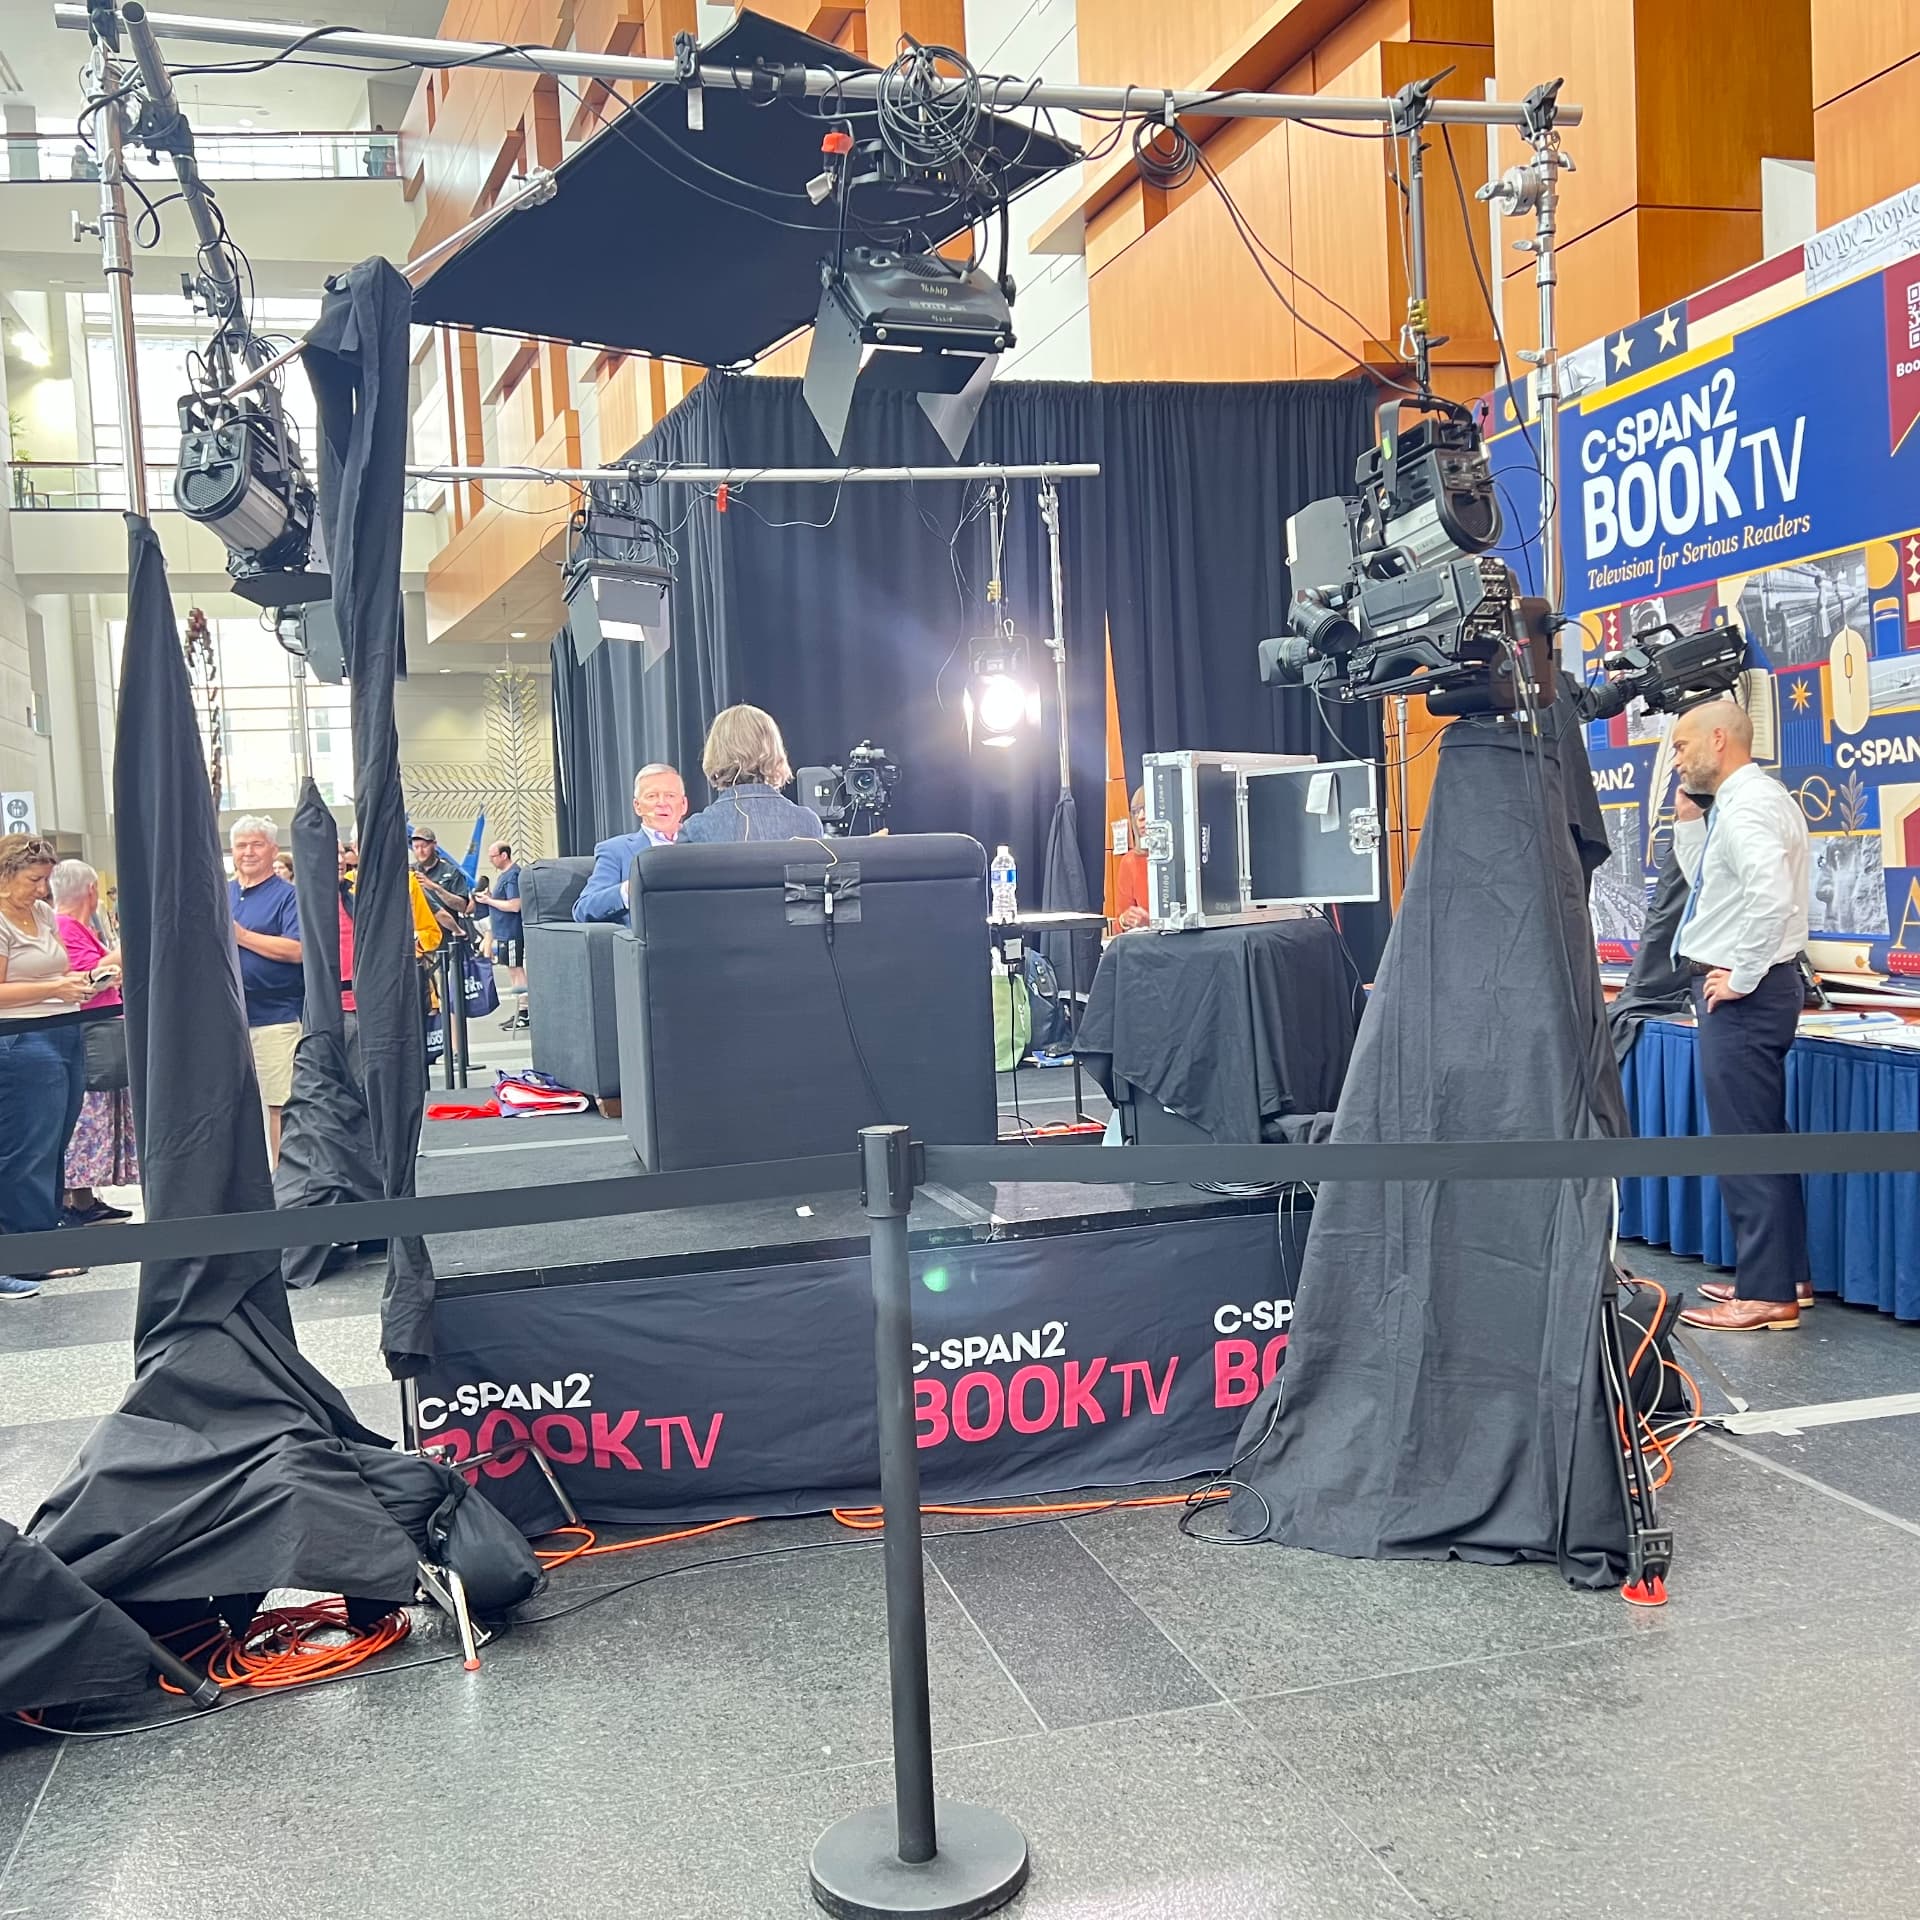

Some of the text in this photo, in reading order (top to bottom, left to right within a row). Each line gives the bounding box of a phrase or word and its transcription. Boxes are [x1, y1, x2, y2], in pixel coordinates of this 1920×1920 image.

[1581, 367, 1738, 474] C-SPAN2
[1587, 514, 1811, 590] Television for Serious Readers
[1590, 762, 1635, 792] PAN2
[1213, 1299, 1296, 1334] C-SP
[417, 1372, 593, 1430] C-SPAN2
